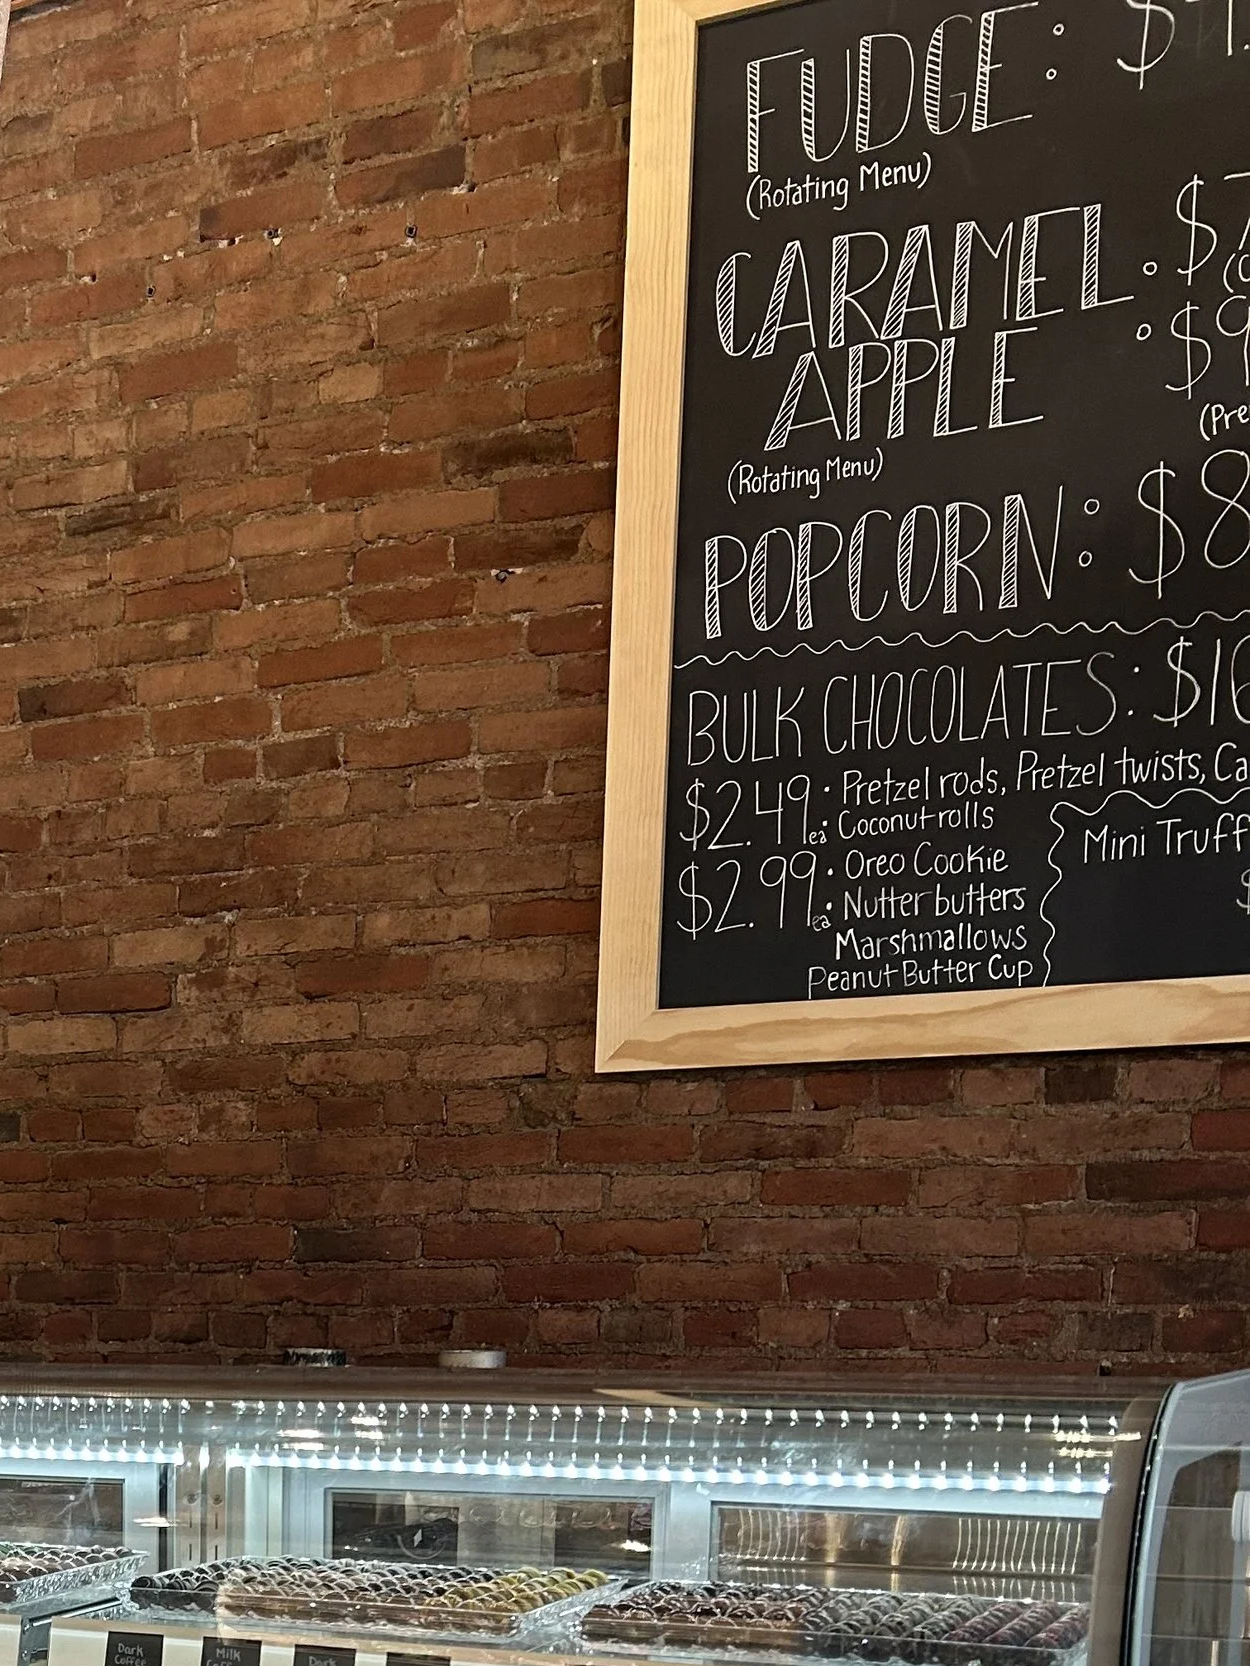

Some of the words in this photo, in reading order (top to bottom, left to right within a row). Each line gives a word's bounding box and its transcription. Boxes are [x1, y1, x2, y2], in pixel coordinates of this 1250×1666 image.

[746, 174, 849, 220] (Rotating
[859, 151, 932, 192] Menu)
[715, 203, 1134, 360] CARAMEL
[763, 325, 1045, 452] APPLE
[727, 459, 821, 505] (Rotating
[825, 447, 885, 482] Menu)
[704, 485, 1100, 640] POPCORN:
[687, 686, 806, 767] BULK
[823, 651, 1141, 756] CHOCOLATES:
[679, 773, 811, 852] $2.49
[842, 765, 931, 807] Pretzel
[939, 756, 1008, 799] rods,
[1016, 749, 1105, 792] Pretzel
[1113, 746, 1206, 785] twists,
[838, 805, 936, 841] Coconut
[937, 800, 996, 831] rolls
[1084, 825, 1146, 864] Mini
[676, 850, 818, 942] $2.99
[845, 849, 906, 880] Oreo
[913, 841, 1010, 877] Cookie
[844, 885, 933, 921] Nutter
[934, 881, 1028, 917] butters
[835, 921, 1029, 962] Marshmallows
[808, 963, 899, 1001] Peanut
[902, 957, 982, 988] Butter
[987, 952, 1035, 988] Cup
[117, 1642, 144, 1657] Dark
[216, 1647, 242, 1662] Milk
